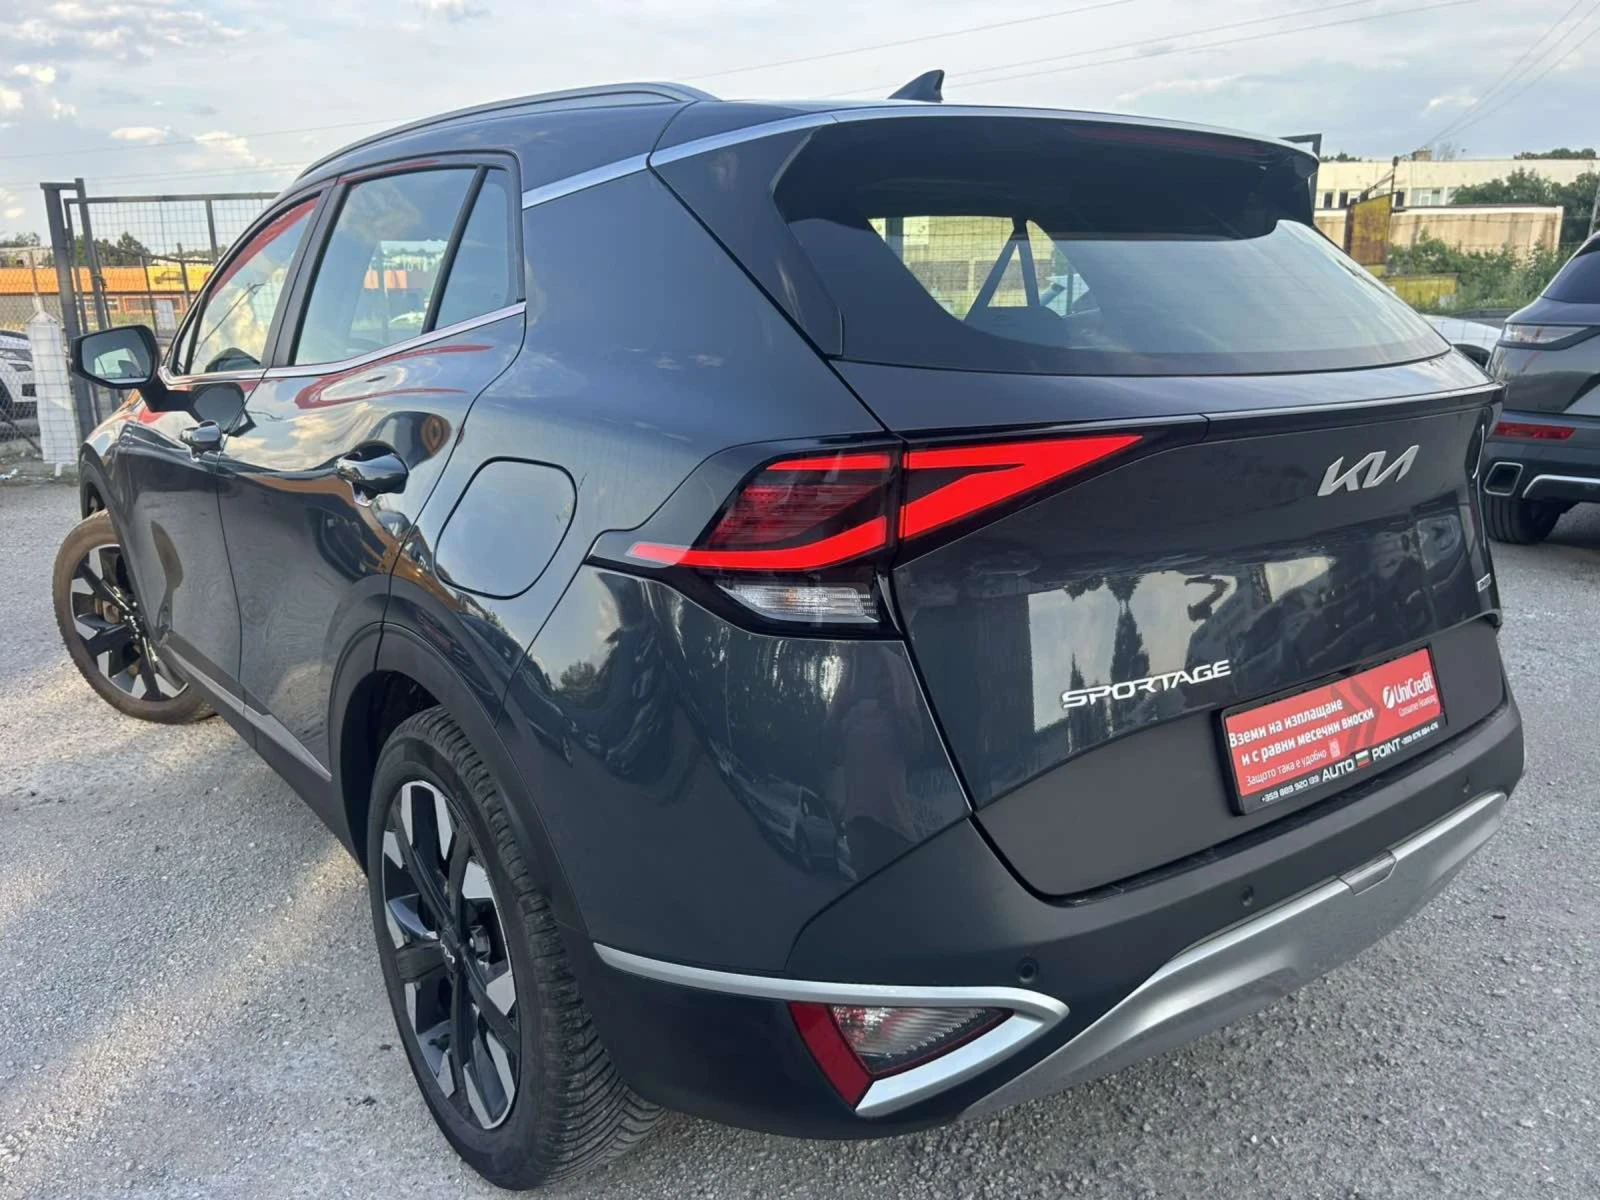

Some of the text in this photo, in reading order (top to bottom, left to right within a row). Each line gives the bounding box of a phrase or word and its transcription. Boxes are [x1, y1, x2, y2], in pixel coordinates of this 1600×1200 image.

[1317, 445, 1419, 496] KIA
[1062, 660, 1231, 708] SPORTAGE
[1394, 671, 1433, 703] UniCredit
[1229, 699, 1343, 748] Вземи на изплащане
[1241, 708, 1374, 766] и с равни месечни вноски
[1246, 768, 1276, 787] Защото
[1277, 761, 1295, 774] така
[1301, 749, 1327, 767] удобно
[1322, 738, 1401, 782] AUTO POINT
